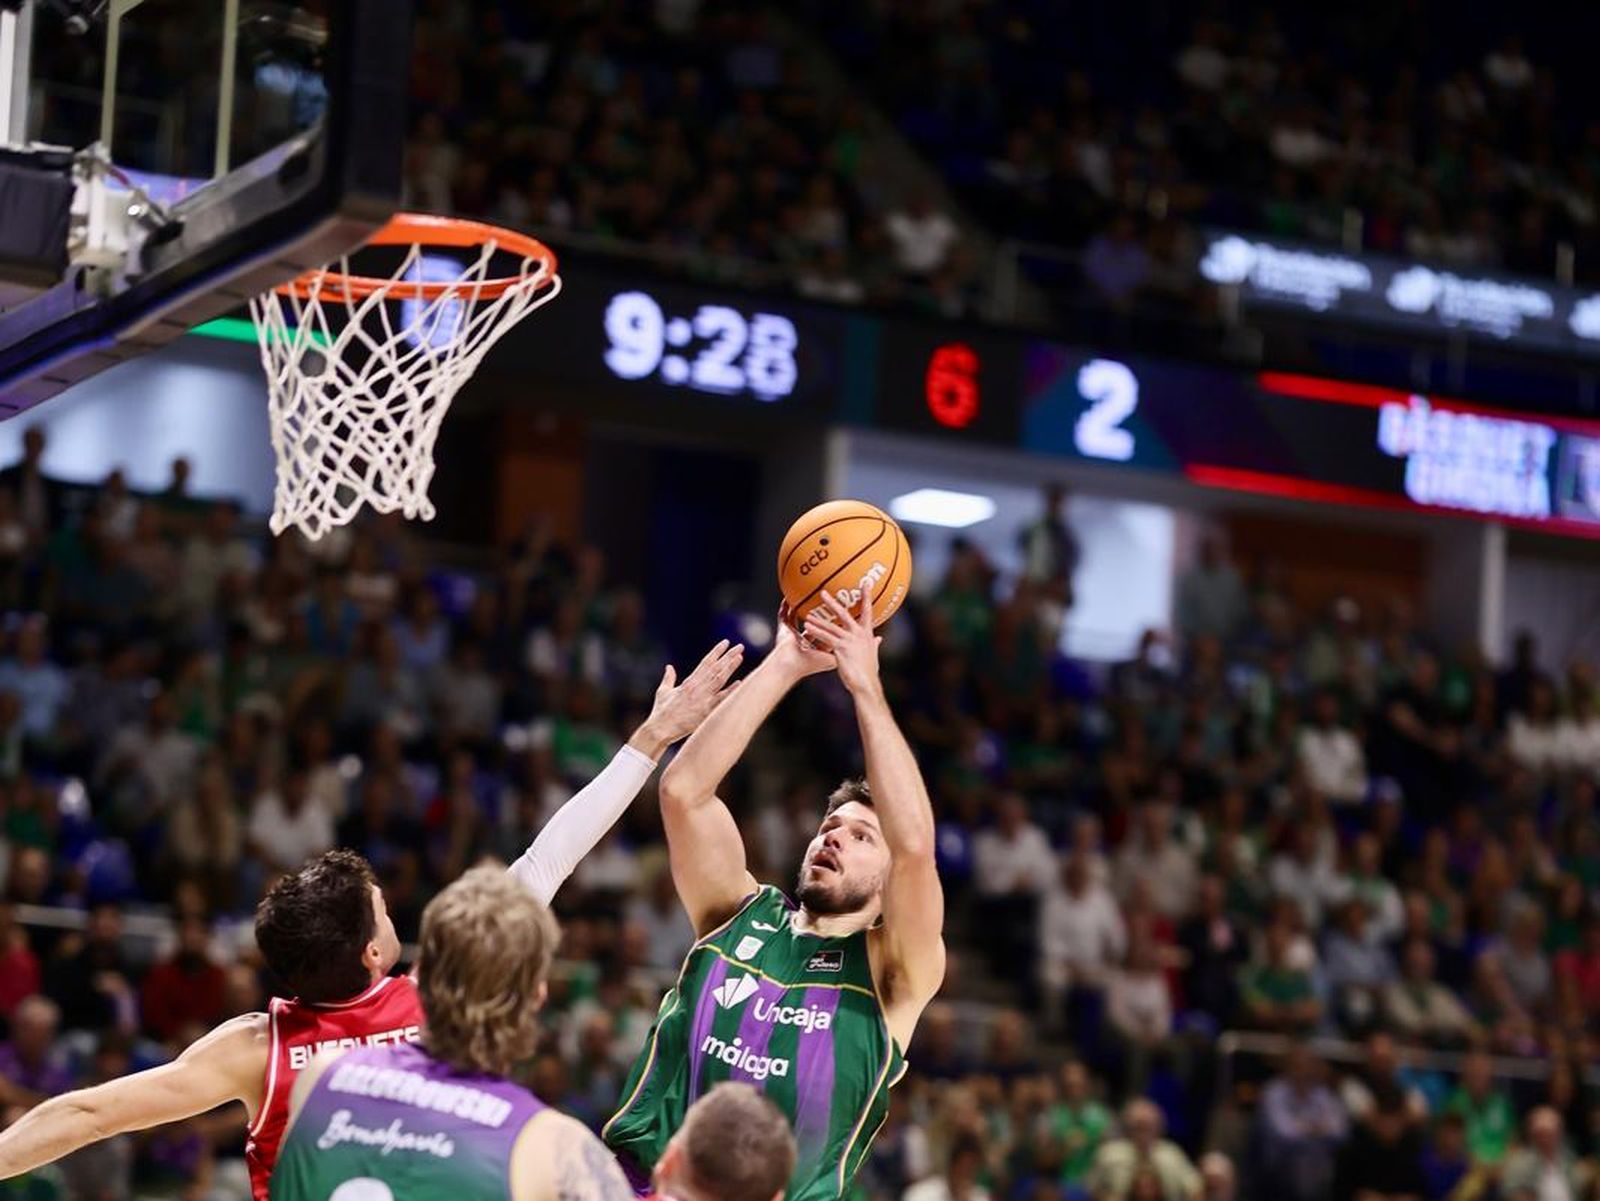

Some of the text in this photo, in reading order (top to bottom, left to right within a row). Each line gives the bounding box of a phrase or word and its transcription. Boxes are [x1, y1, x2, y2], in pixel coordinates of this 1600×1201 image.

[925, 342, 980, 429] 6
[1074, 358, 1138, 462] 2
[800, 549, 829, 576] acb
[753, 997, 831, 1034] Uncaja
